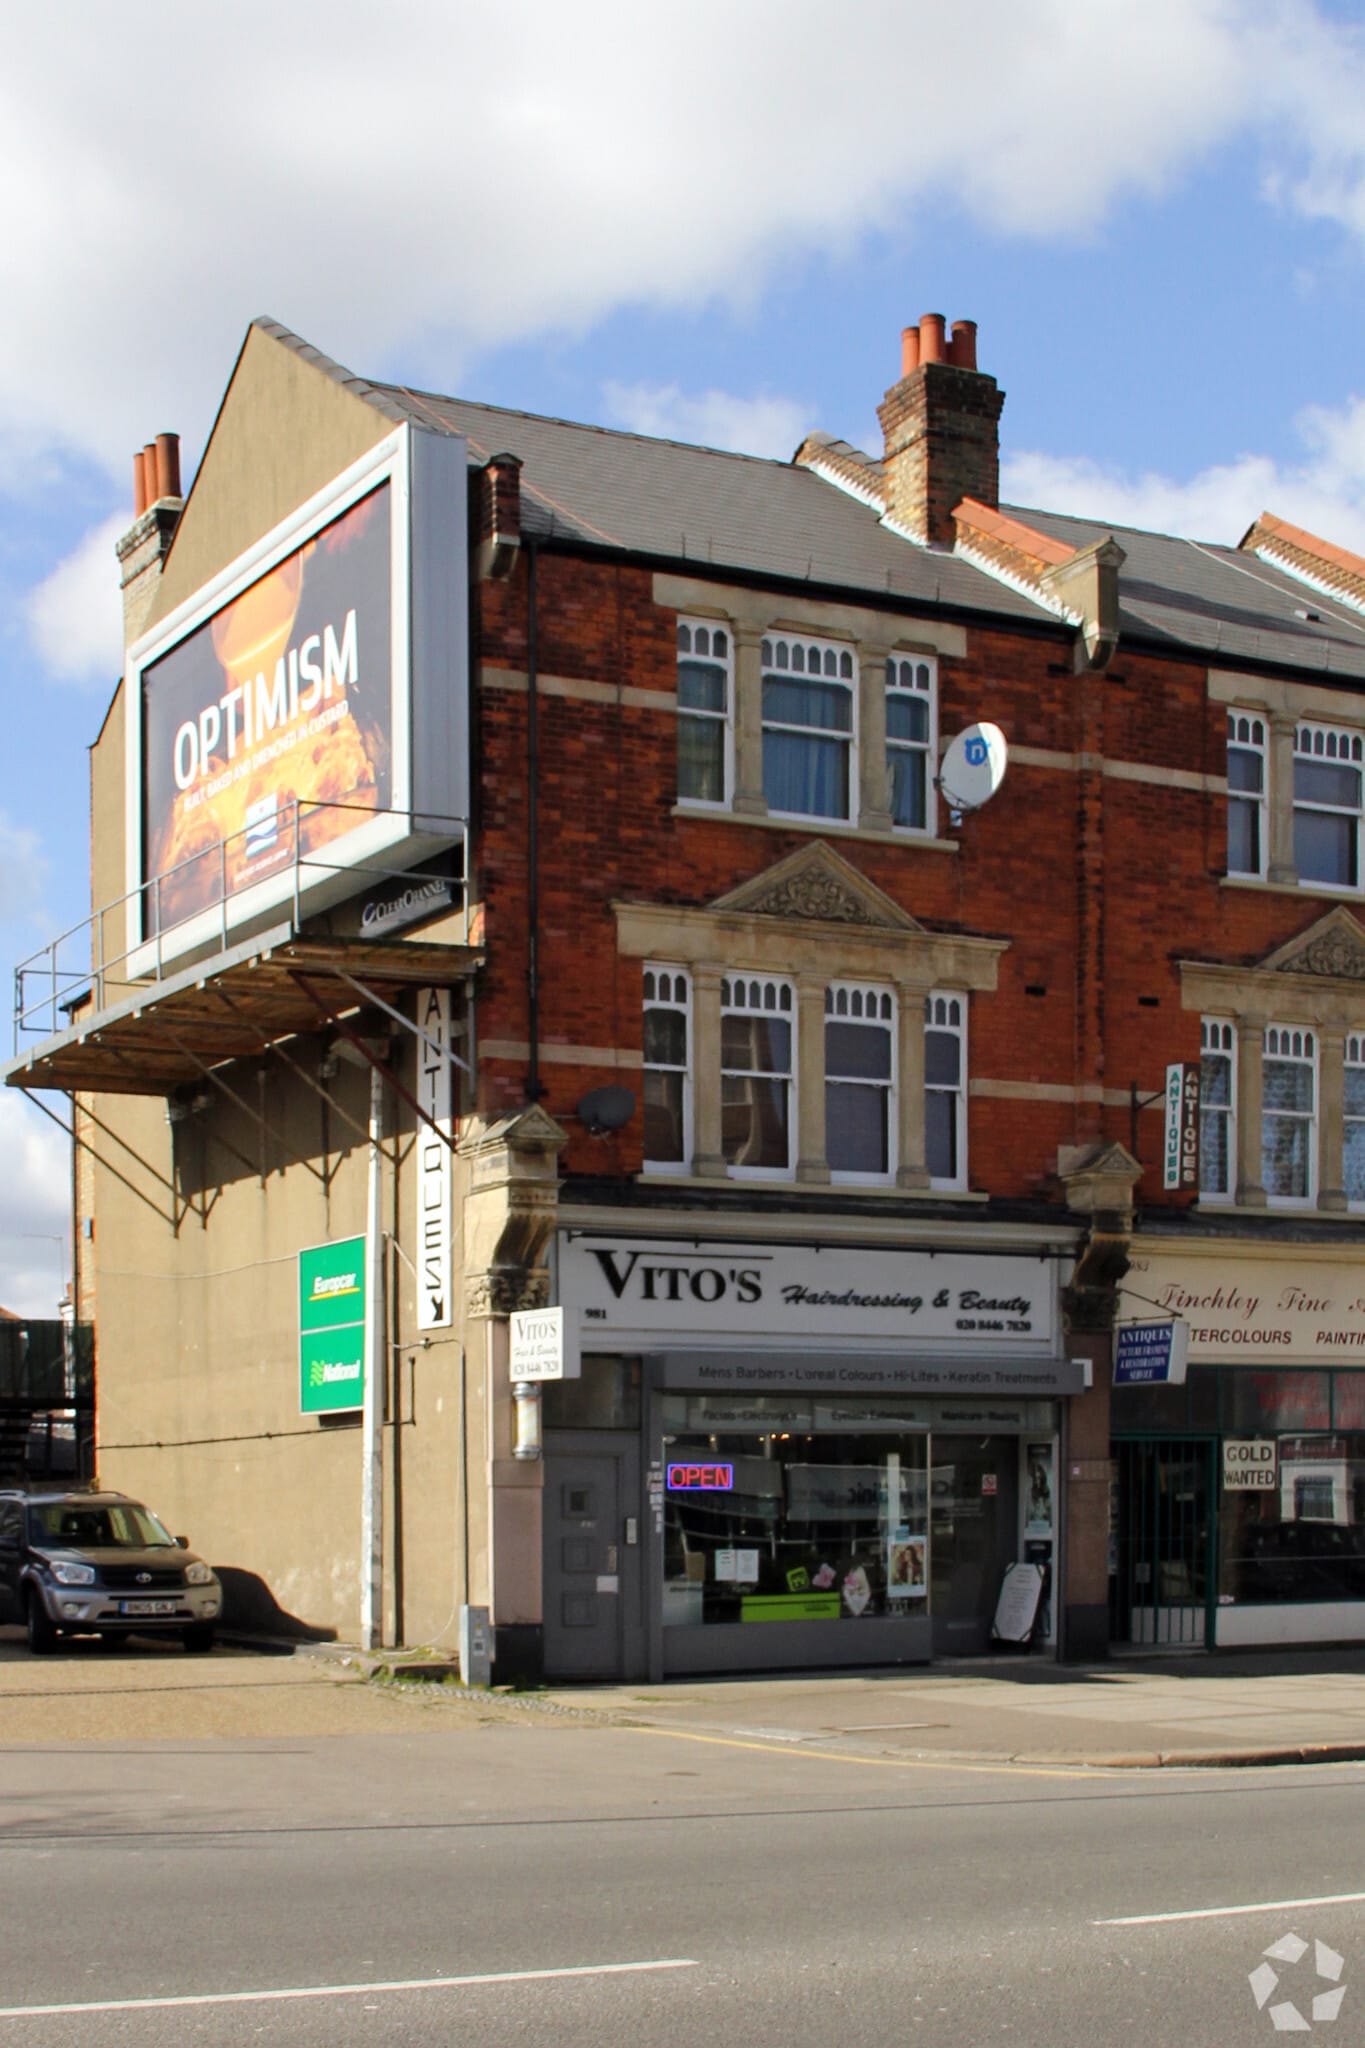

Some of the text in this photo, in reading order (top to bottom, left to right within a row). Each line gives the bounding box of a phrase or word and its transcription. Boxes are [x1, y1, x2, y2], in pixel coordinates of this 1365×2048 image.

[174, 609, 358, 790] OPTIMISM
[424, 987, 444, 1291] ANTIQUES
[1168, 1071, 1180, 1182] ANTIQUES
[1183, 1071, 1199, 1182] ANTIQUES
[314, 1272, 356, 1295] Europcar
[585, 1249, 762, 1303] VITO'S
[781, 1284, 1031, 1316] Hairdressing & Beauty
[1155, 1283, 1260, 1320] Finchley
[1277, 1286, 1334, 1312] Fine
[1121, 1328, 1172, 1343] ANTIQUES
[699, 1366, 732, 1379] Mens
[736, 1367, 785, 1380] Barbers
[839, 1369, 884, 1381] Colours
[948, 1371, 991, 1383] Keratin
[994, 1371, 1057, 1384] Treatments
[1226, 1446, 1272, 1462] GOLD
[671, 1466, 730, 1487] OPEN
[1224, 1470, 1274, 1485] WANTED
